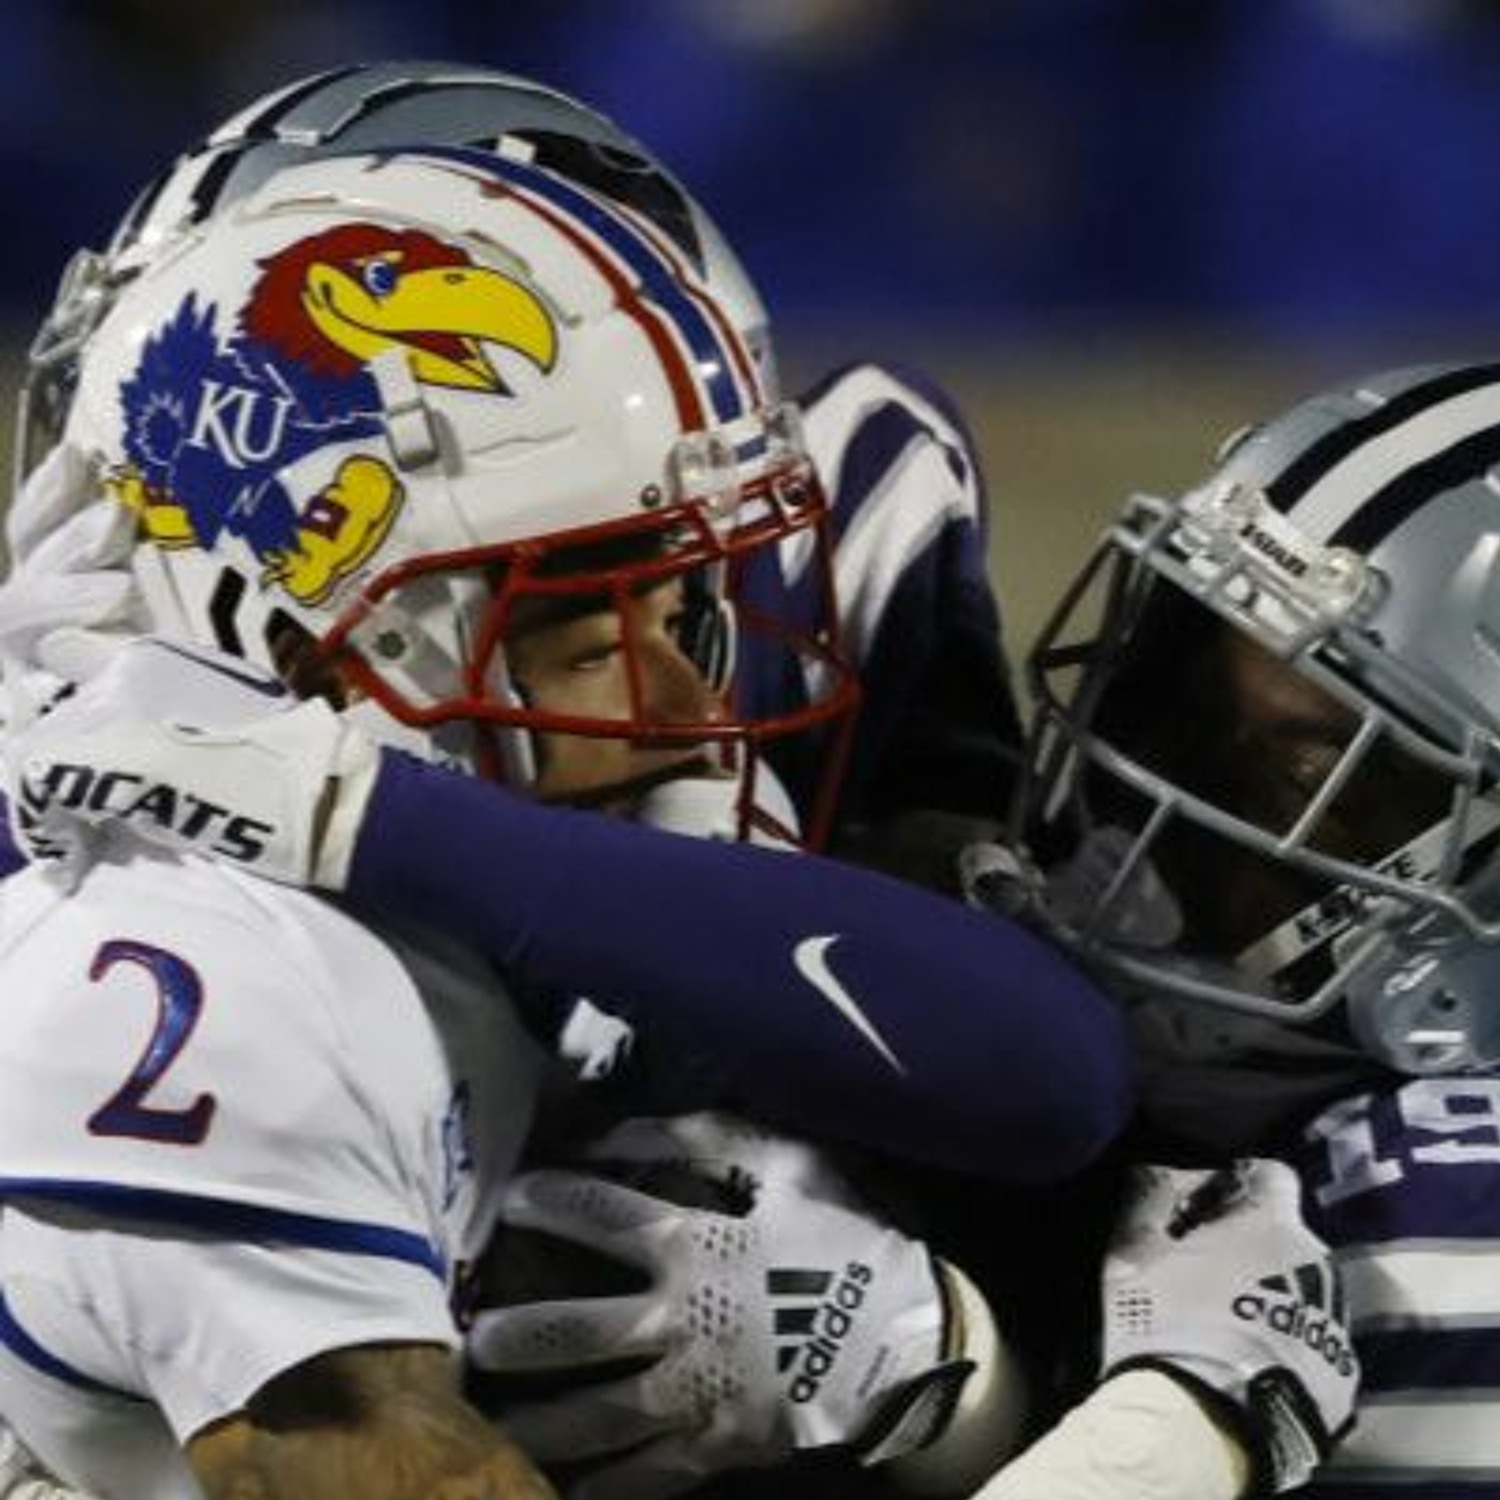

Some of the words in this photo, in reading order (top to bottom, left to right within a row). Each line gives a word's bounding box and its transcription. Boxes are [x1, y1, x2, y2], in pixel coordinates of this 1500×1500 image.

[185, 378, 297, 470] KU
[86, 938, 217, 1145] 2
[789, 1262, 873, 1403] adidas
[1232, 1294, 1353, 1377] adidas
